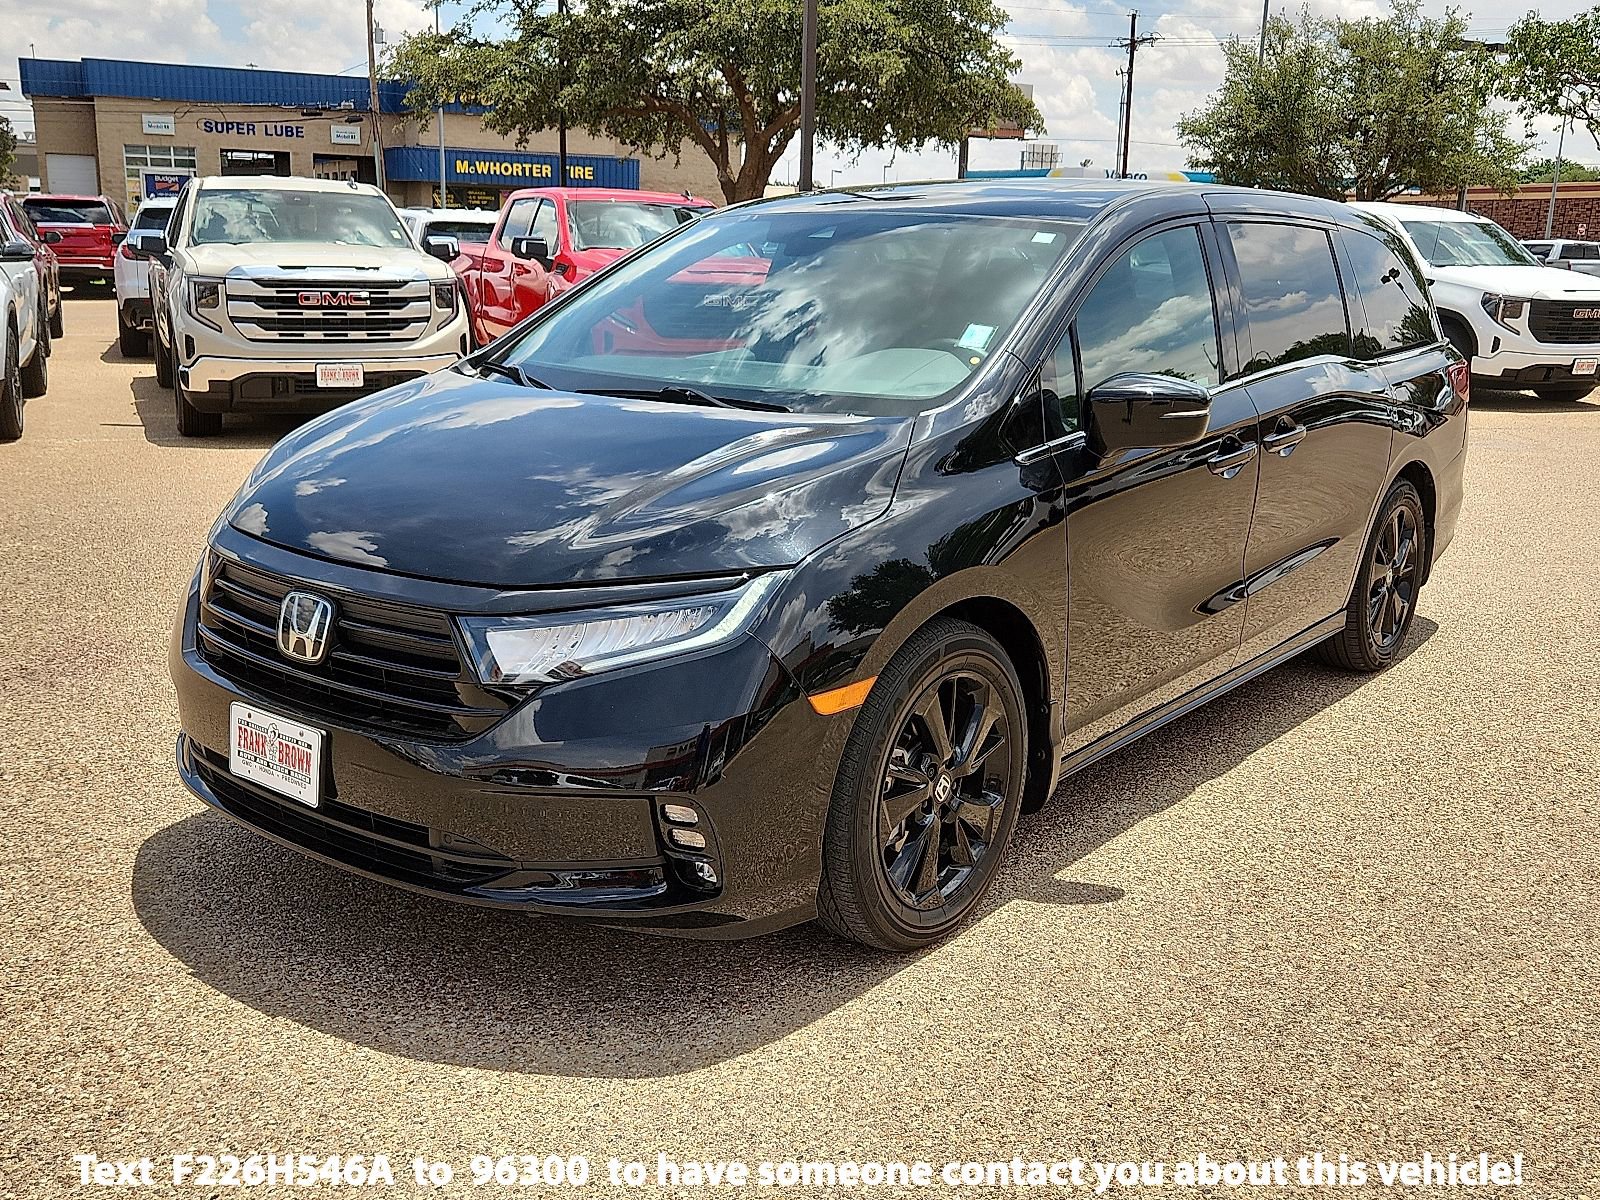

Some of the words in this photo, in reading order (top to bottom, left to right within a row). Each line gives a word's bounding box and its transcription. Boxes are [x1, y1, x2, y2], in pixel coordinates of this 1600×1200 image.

[203, 120, 256, 136] SUPER
[264, 124, 305, 138] LUBE
[455, 159, 552, 178] McWHORTER
[565, 164, 594, 180] IRE
[154, 175, 180, 184] Budget
[298, 291, 371, 306] GMC
[237, 725, 268, 759] FRANK
[278, 740, 312, 776] BROWN
